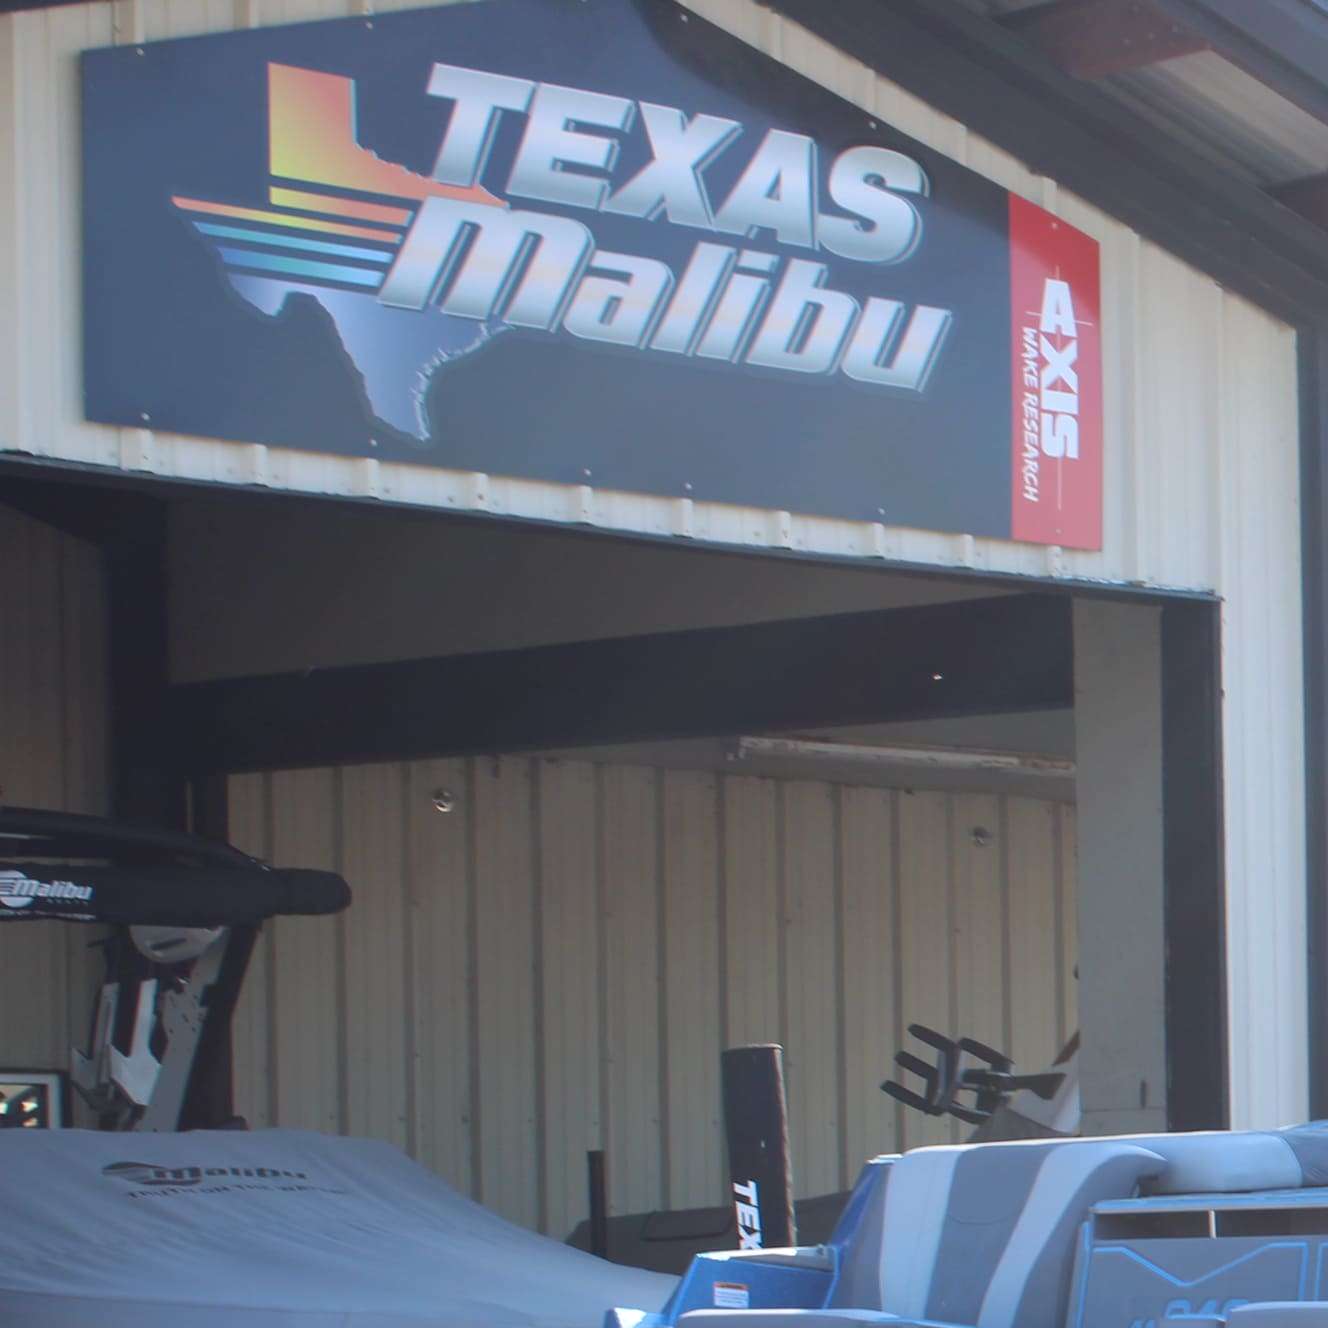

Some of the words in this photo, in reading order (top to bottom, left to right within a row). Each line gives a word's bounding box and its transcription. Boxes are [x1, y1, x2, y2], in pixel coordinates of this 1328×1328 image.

[426, 62, 931, 266] TEXAS
[377, 196, 952, 393] Malibu
[1021, 326, 1040, 390] WAKE
[1039, 277, 1079, 460] AXIS
[1021, 391, 1040, 503] RESEARCH
[15, 879, 93, 900] Malibu
